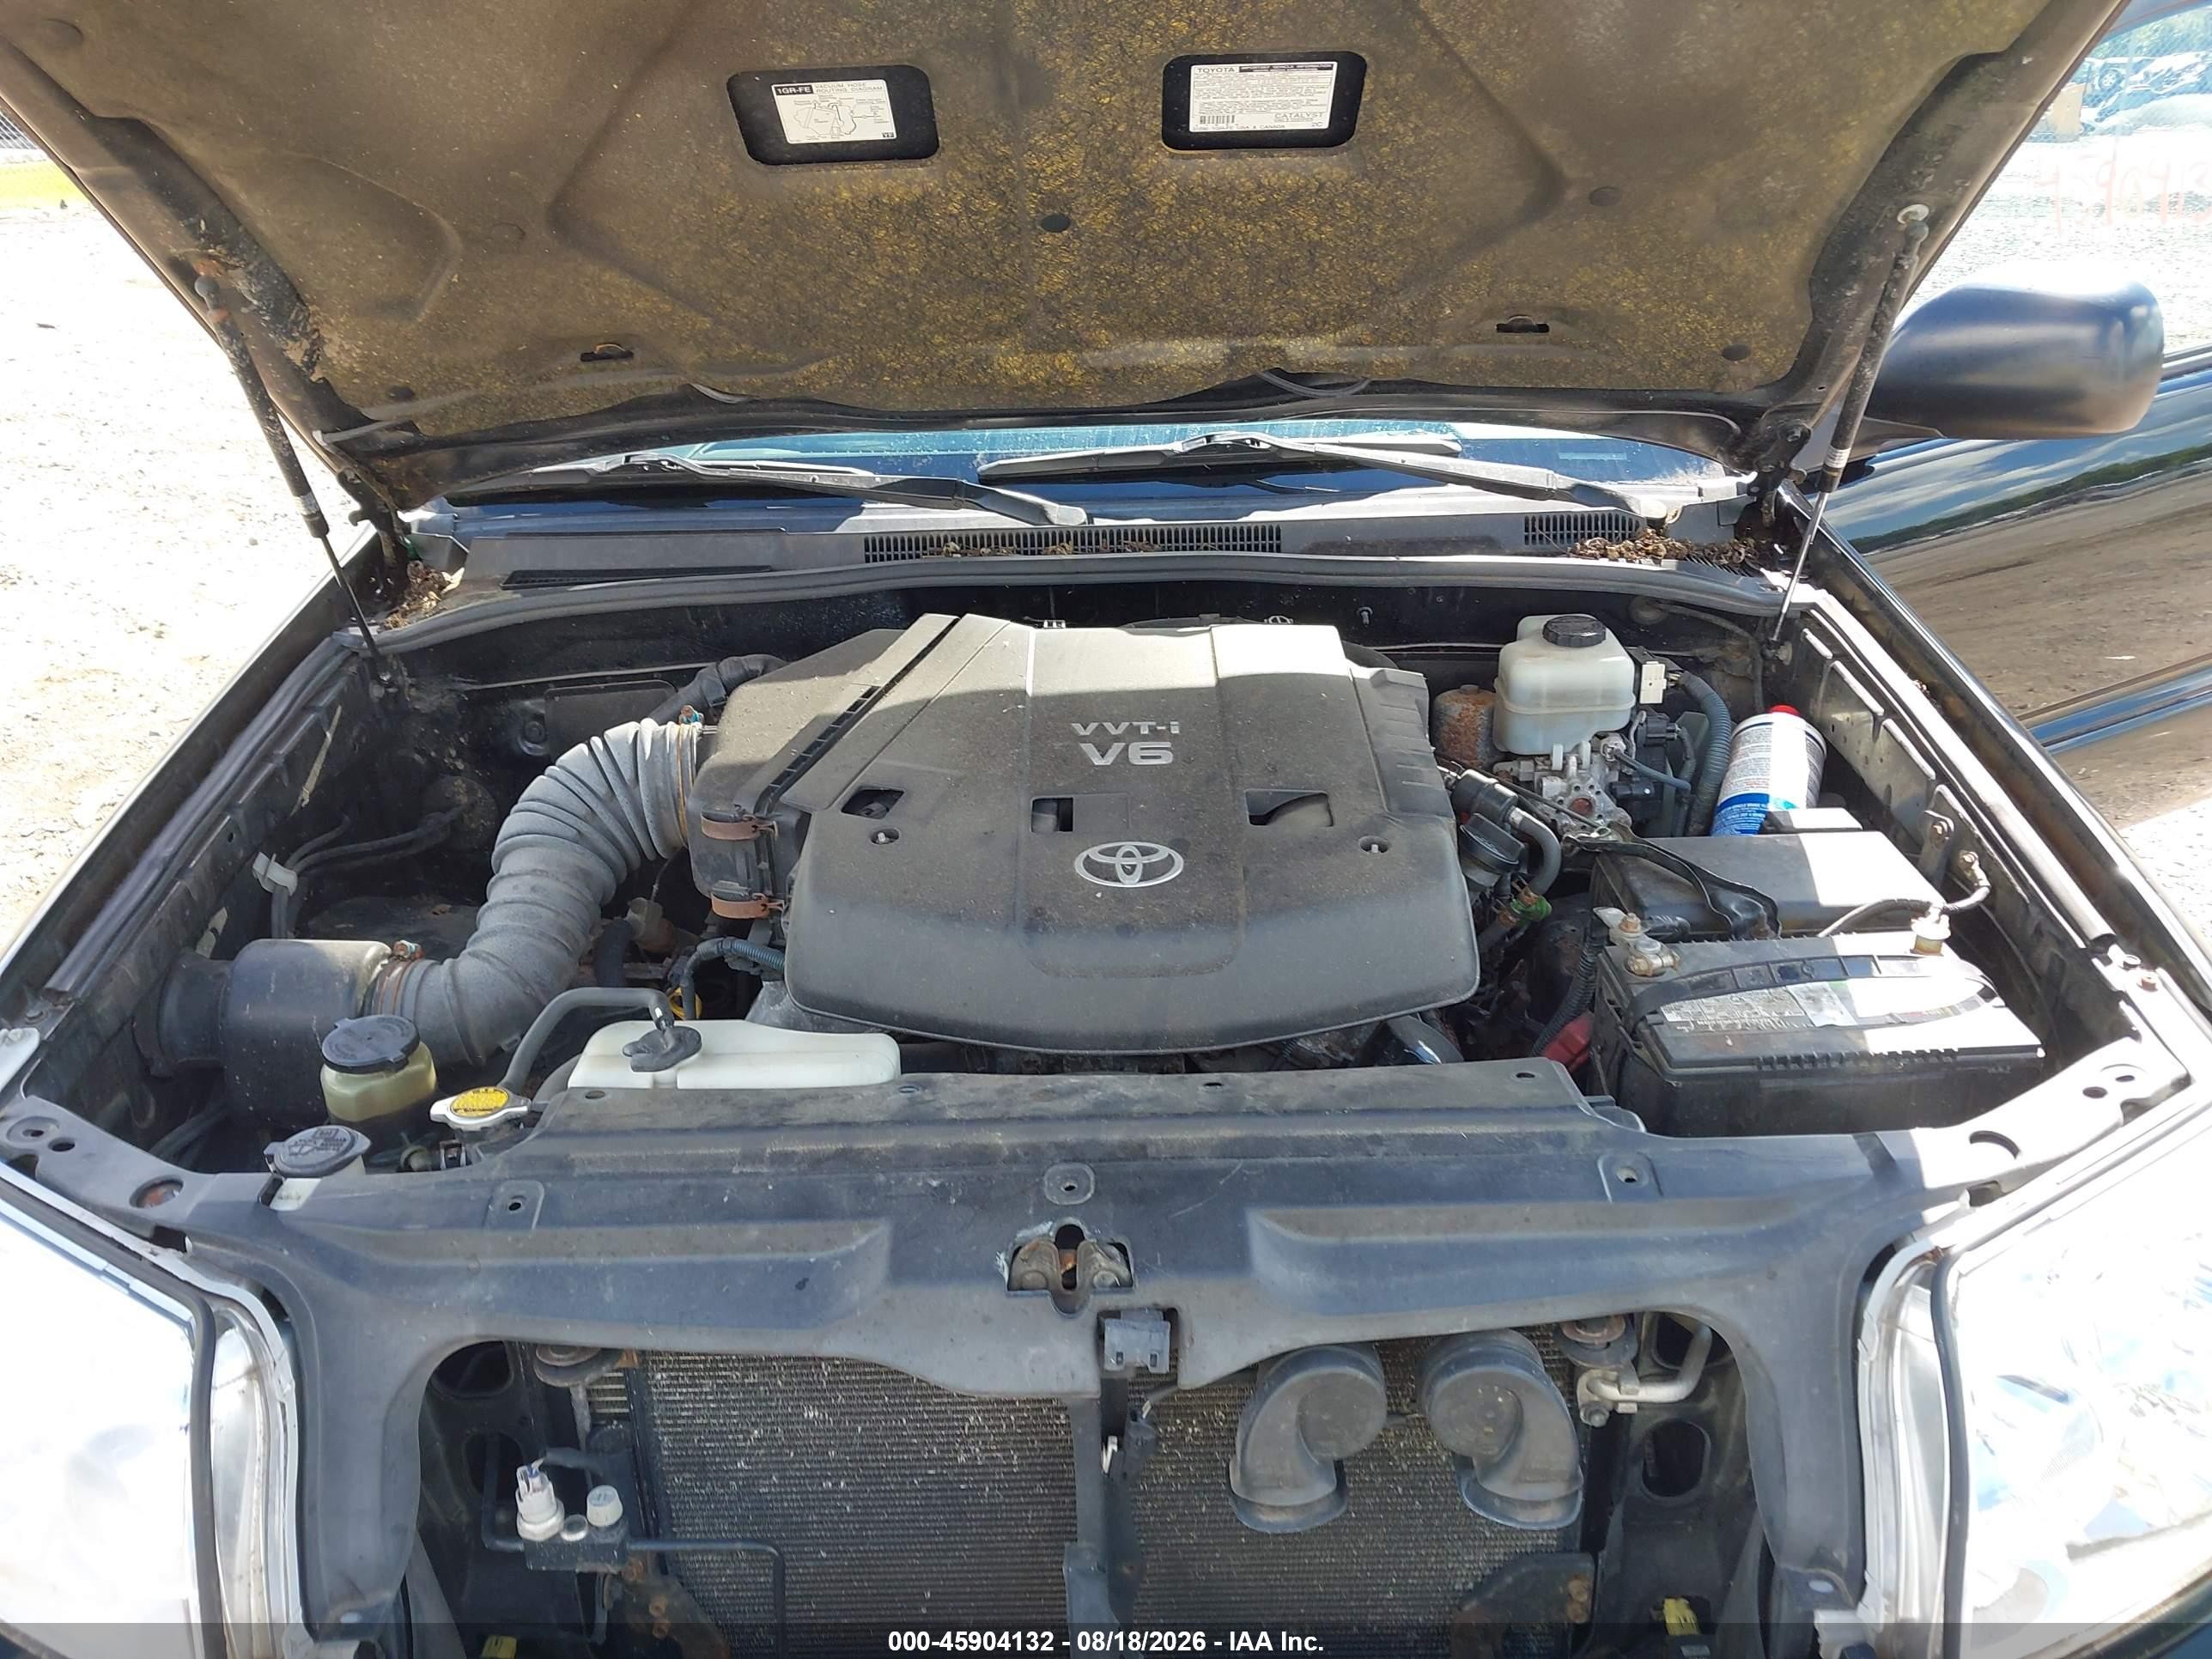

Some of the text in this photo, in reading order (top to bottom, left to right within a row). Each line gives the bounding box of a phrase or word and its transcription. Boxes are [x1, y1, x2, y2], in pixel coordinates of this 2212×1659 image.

[776, 86, 811, 94] 1GR-FE
[1071, 721, 1180, 736] VVT-i
[1079, 741, 1174, 766] V6
